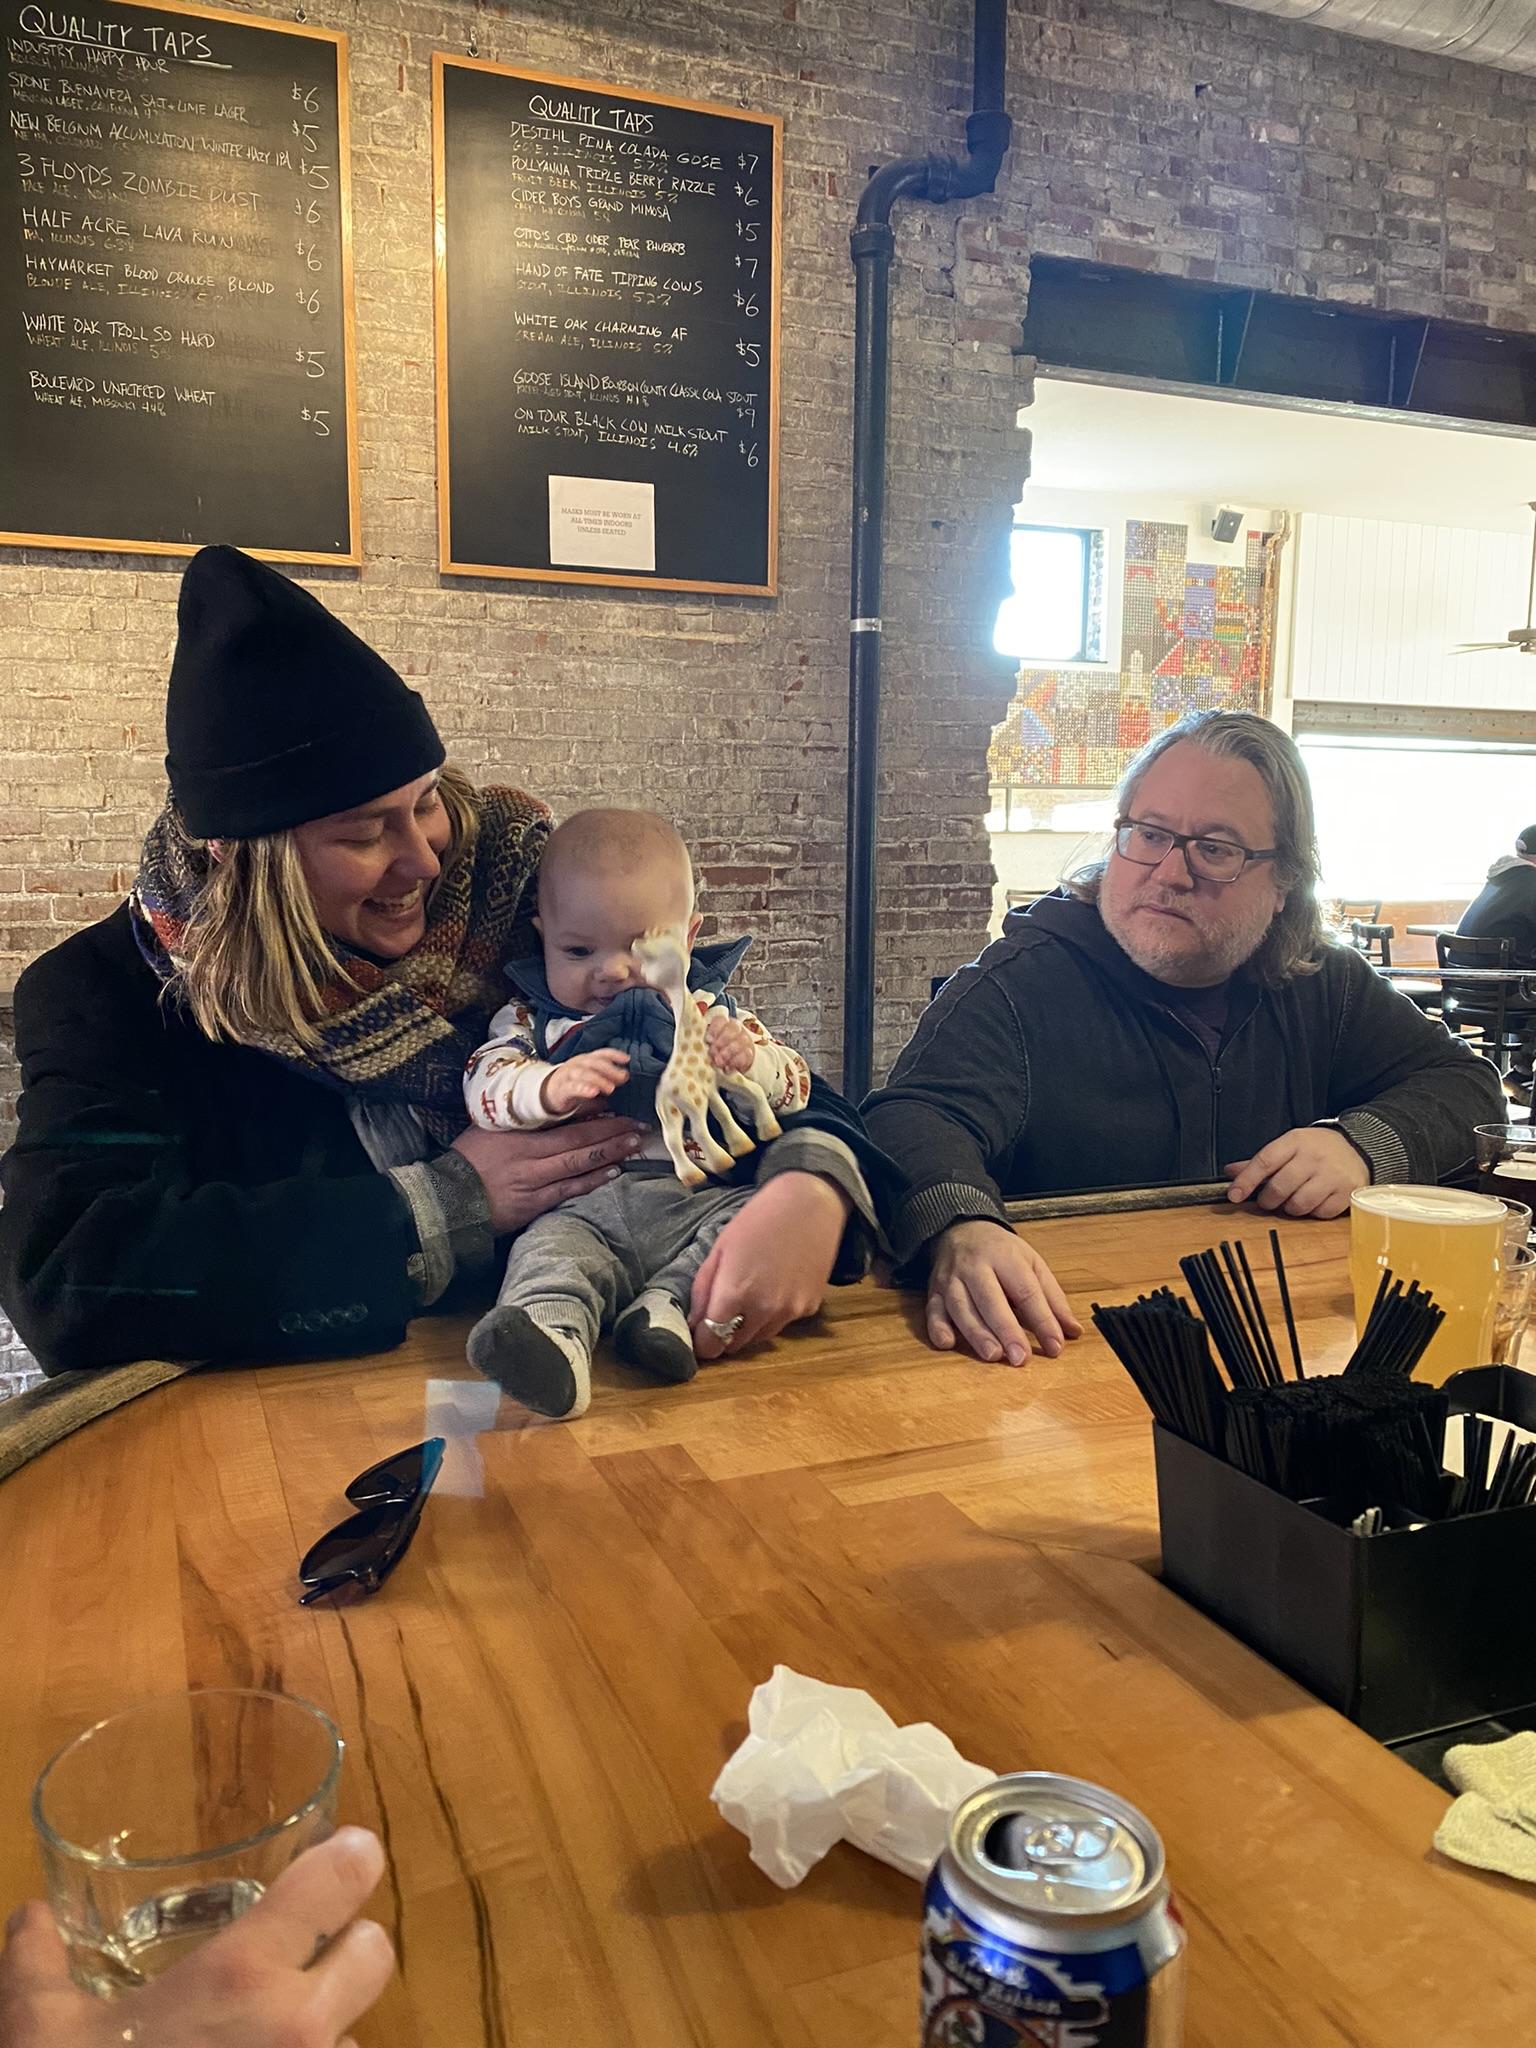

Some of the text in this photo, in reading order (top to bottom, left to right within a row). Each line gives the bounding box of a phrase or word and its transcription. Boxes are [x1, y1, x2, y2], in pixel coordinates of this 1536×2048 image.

[19, 4, 212, 58] QUALITY TAPS
[7, 37, 171, 74] INDUSTRY HAPPY HOUR
[8, 71, 51, 91] STONE
[140, 94, 168, 111] SALT
[178, 100, 206, 115] LIME
[214, 103, 248, 123] LAGER
[292, 81, 319, 113] $6
[528, 94, 655, 134] QUALITY TAPS
[10, 110, 40, 131] NEW
[201, 137, 243, 158] WINTER
[246, 146, 271, 165] HAZY
[275, 151, 292, 169] IPA
[292, 120, 319, 152] $5
[510, 121, 724, 171] DESTIHL PINA COLADA GOSE
[299, 158, 330, 190] $5
[511, 155, 716, 196] POLLYANNA TRIPLE BERRY RAZZLE
[738, 152, 759, 175] $7
[16, 153, 262, 211] 3 FLOYDS ZOMBIE DUST
[512, 172, 543, 185] FRUIT
[586, 182, 647, 199] ILLINOIS
[734, 181, 760, 206] $6
[294, 198, 321, 224] $6
[511, 187, 672, 222] CIDER BOYS GRAND MIMOSA
[22, 206, 234, 249] HALF ACRE LAVA RUN
[513, 226, 550, 241] OTTO'S
[557, 232, 578, 244] CBD
[585, 233, 610, 246] CIDER
[618, 236, 640, 250] PEAR
[646, 240, 686, 256] RHUBARB
[735, 218, 760, 242] $5
[295, 238, 322, 271] $6
[735, 254, 758, 279] $7
[25, 253, 275, 294] HAYMARKET BLOOD ORANGE BLOND
[515, 263, 703, 296] HAND OF FATE TIPPING COWS
[296, 288, 320, 314] $6
[732, 288, 759, 318] $6
[22, 311, 215, 348] WHITE OAK TROLL SO HARD
[26, 332, 64, 347] WHEAT
[514, 311, 688, 341] WHITE OAK CHARMING AF
[515, 330, 554, 344] CREAM
[589, 337, 642, 353] ILLINOIS
[735, 337, 761, 367] $5
[296, 347, 326, 378] $5
[29, 370, 96, 393] BOULEVARD
[174, 386, 216, 407] WHEAT
[33, 391, 65, 406] WHEAT
[513, 368, 552, 386] GOOSE
[560, 373, 600, 391] ISLAND
[601, 375, 639, 393] BOURBON
[726, 391, 758, 405] STOUT
[301, 406, 330, 436] $5
[514, 407, 729, 443] ON TOUR BLACK COW MILK STOUT
[737, 406, 756, 428] $9
[518, 424, 551, 435] MILK
[597, 431, 657, 450] ILLINOIS
[738, 440, 759, 468] $6
[561, 507, 583, 515] MASKS
[584, 508, 601, 516] MUST
[602, 510, 611, 518] BE
[611, 511, 631, 519] WORN
[583, 518, 602, 526] TIMES
[603, 519, 633, 528] INDOORS
[577, 526, 627, 536] UNLESS SEATED
